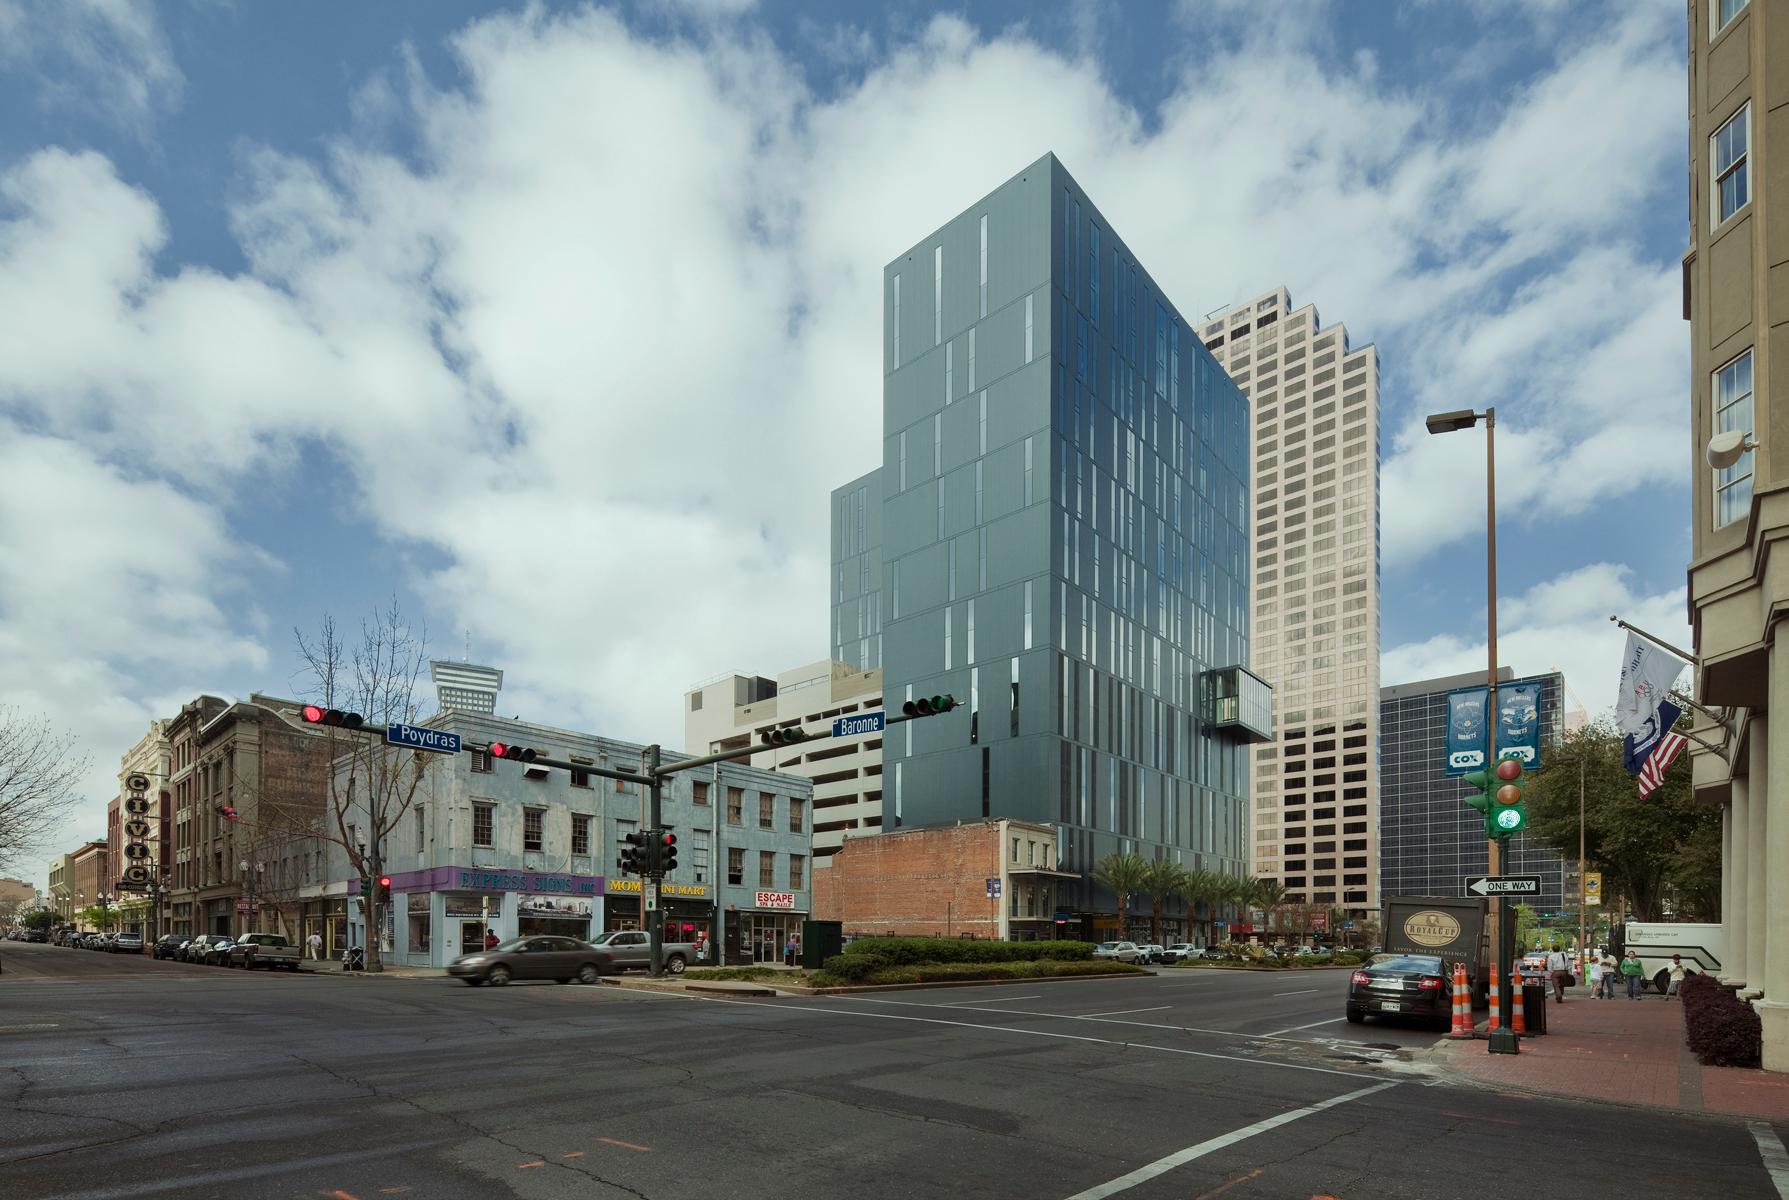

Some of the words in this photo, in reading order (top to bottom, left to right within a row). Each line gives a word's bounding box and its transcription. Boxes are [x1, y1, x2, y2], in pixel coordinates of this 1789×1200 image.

[841, 717, 879, 735] Baronne
[401, 725, 456, 748] Poydras
[1454, 755, 1478, 764] COX
[127, 776, 148, 882] CIVIC
[460, 871, 528, 890] EXPRESS
[1487, 882, 1509, 891] ONE
[1511, 881, 1533, 890] WAY
[678, 885, 705, 896] MART
[757, 892, 793, 903] ESCAPE
[1429, 949, 1468, 957] EXPERIENCE
